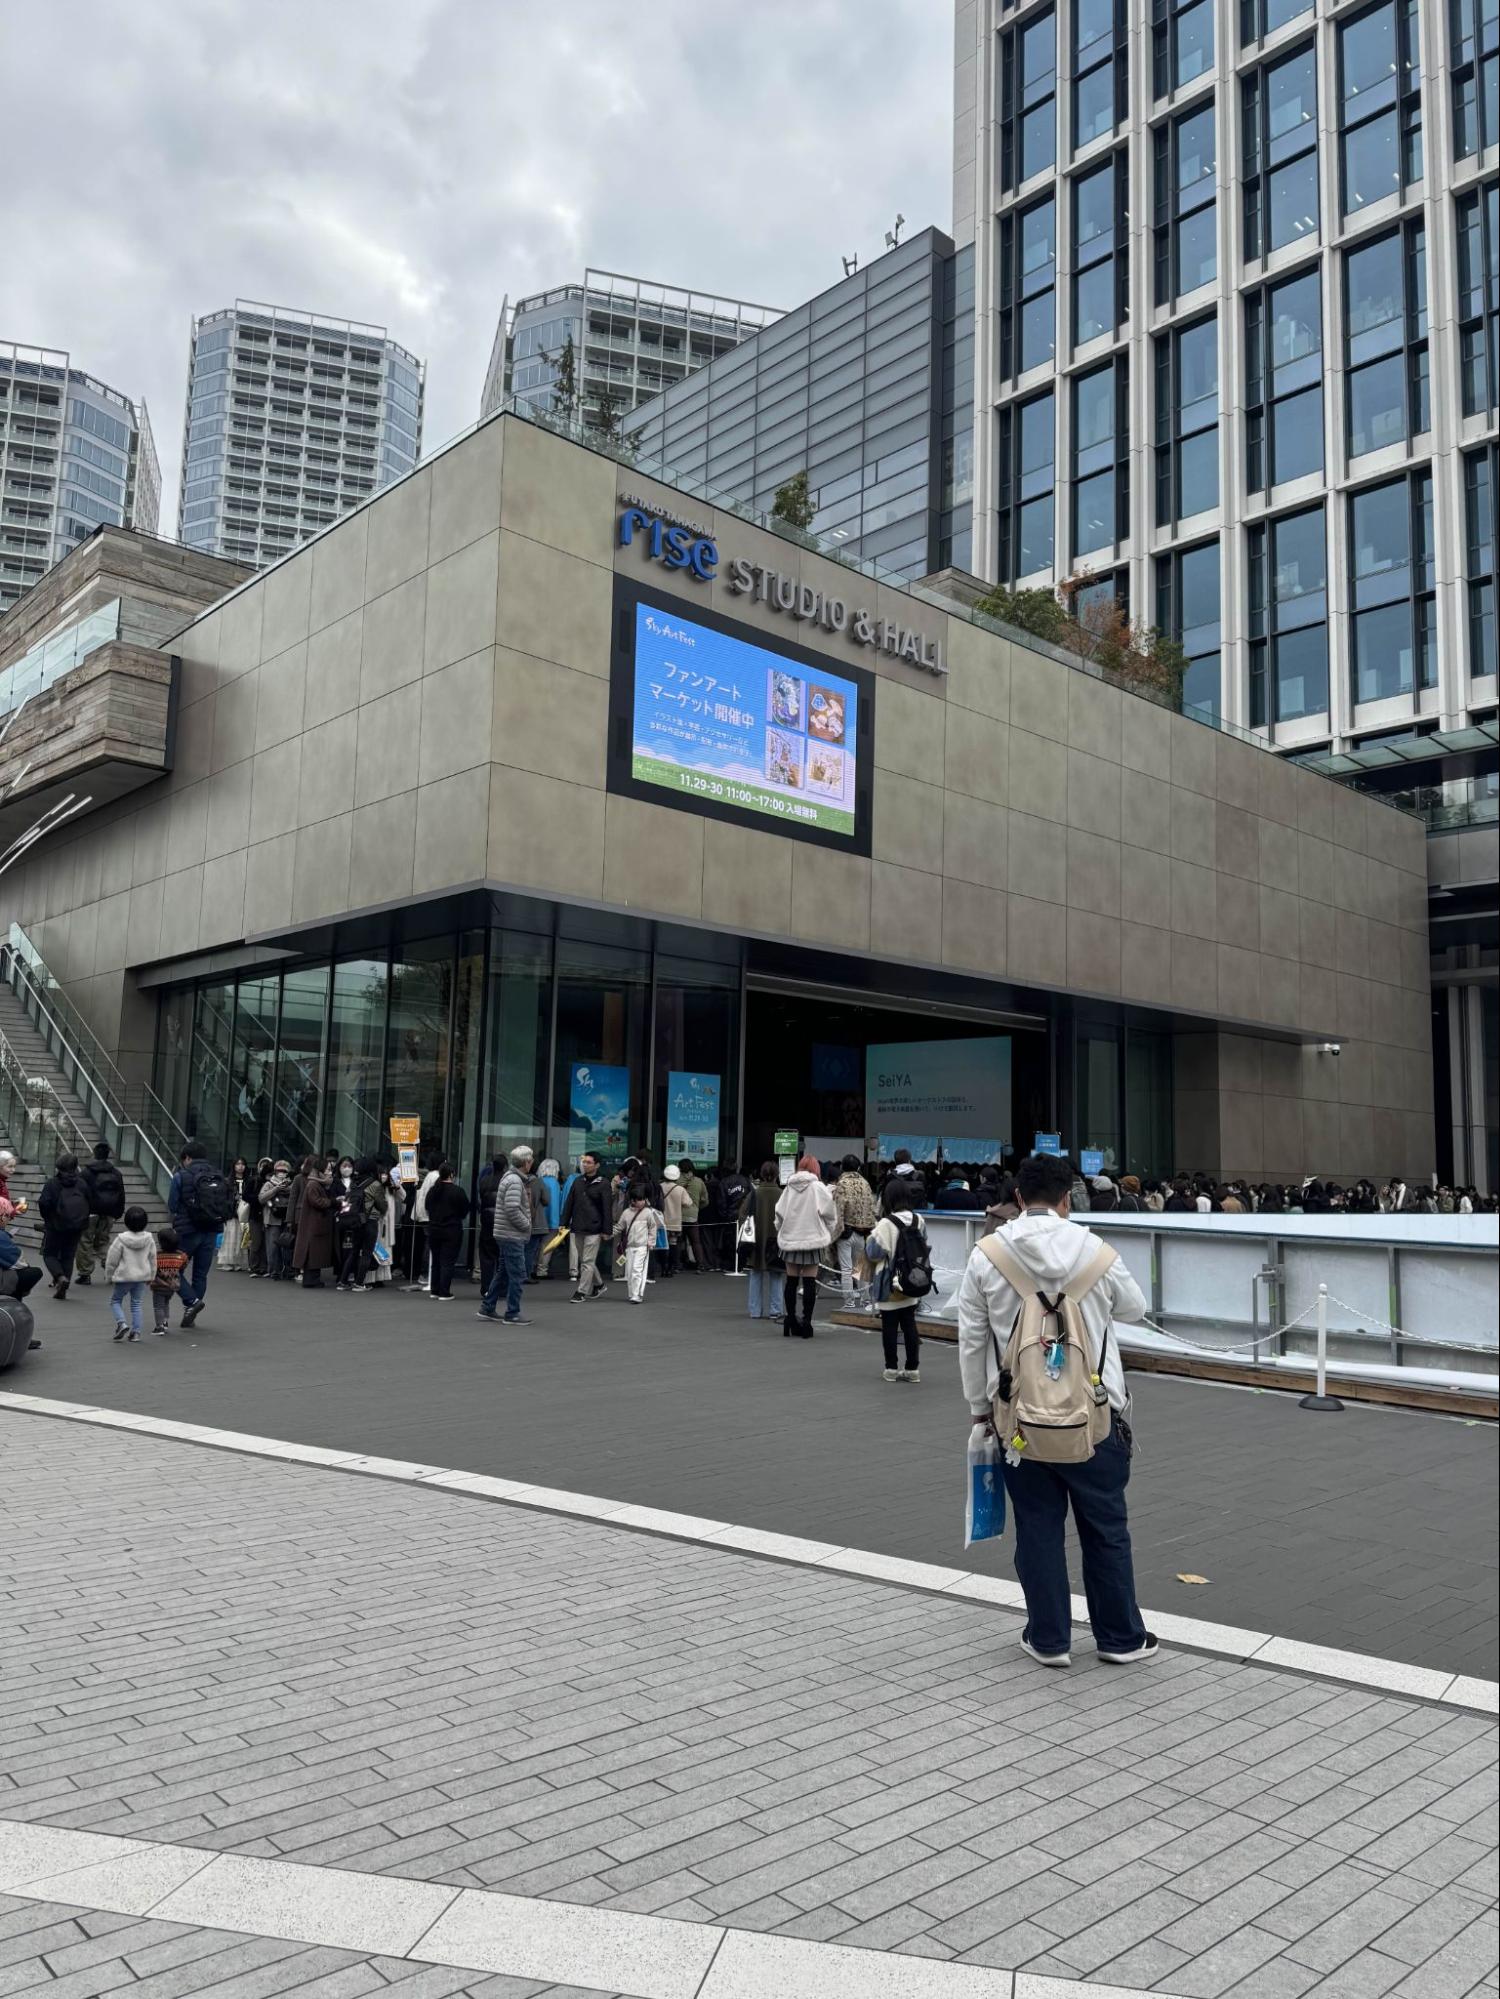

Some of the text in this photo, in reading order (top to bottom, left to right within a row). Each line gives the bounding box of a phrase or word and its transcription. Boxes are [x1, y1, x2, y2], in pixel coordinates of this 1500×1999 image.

[620, 507, 949, 676] rise STUDIO & HALL
[664, 661, 742, 701] ファンアート
[649, 682, 755, 730] マーケット開催中
[680, 773, 723, 795] 11.29-30
[879, 1074, 912, 1088] SeiYA
